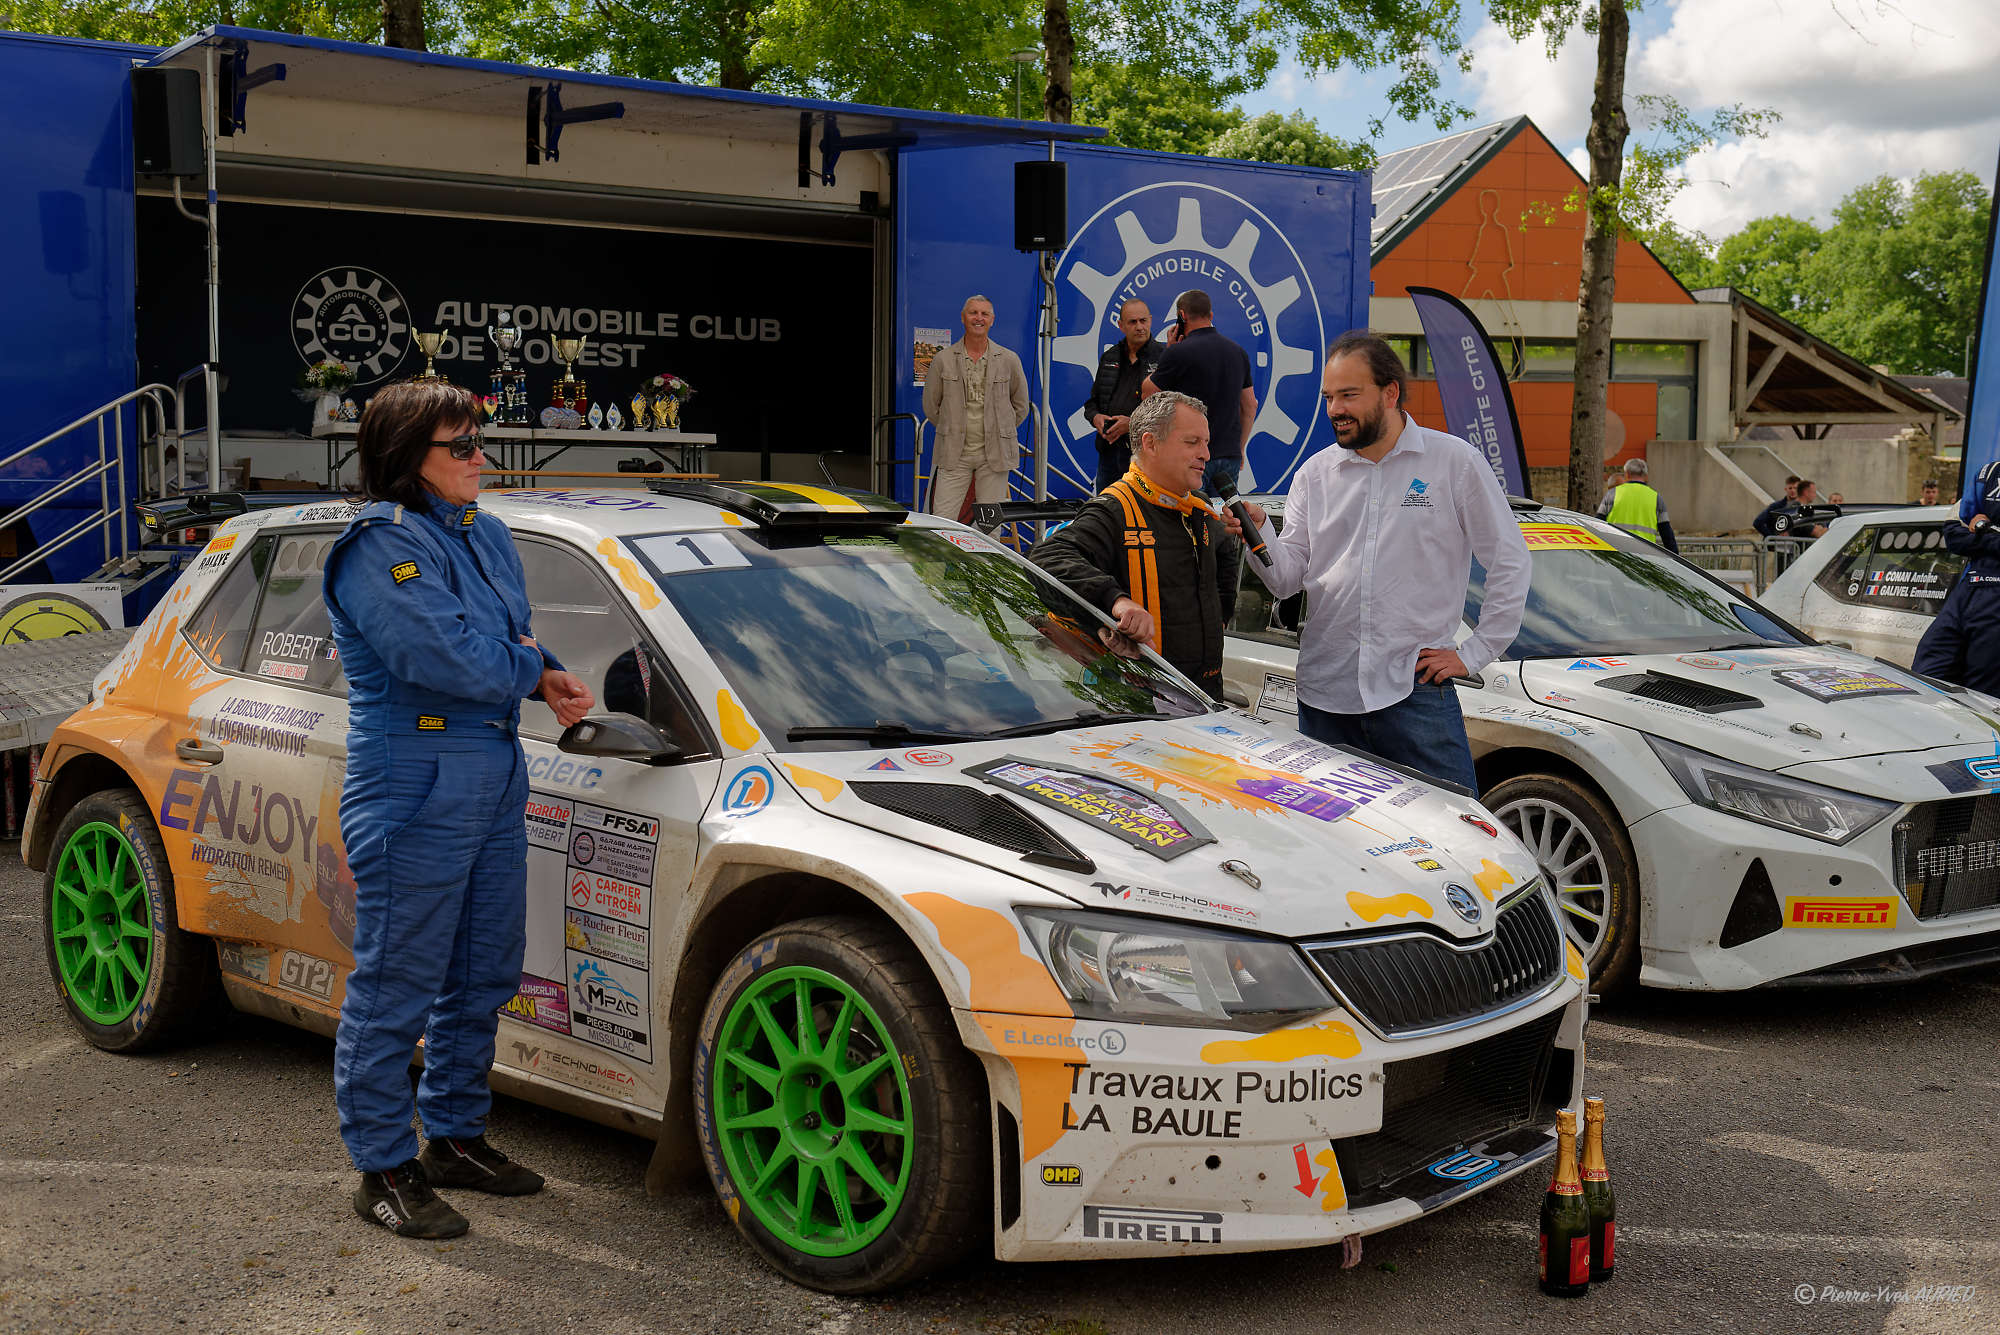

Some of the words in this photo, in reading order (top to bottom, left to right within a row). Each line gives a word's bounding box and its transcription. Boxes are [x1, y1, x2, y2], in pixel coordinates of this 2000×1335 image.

[319, 291, 368, 317] AUTOMOBILE
[368, 299, 385, 320] CLUB
[1228, 279, 1264, 337] CLUB
[434, 300, 679, 337] AUTOMOBILE
[689, 314, 782, 341] CLUB
[435, 335, 485, 361] DE
[302, 505, 341, 521] BRETAGNE
[675, 536, 715, 566] 1
[1122, 530, 1156, 546] 56
[198, 552, 231, 570] RALLYE
[393, 563, 418, 581] OMP
[1885, 571, 1912, 582] CONAN
[1910, 572, 1938, 584] Antoine
[1880, 585, 1909, 597] GALIVEL
[1909, 586, 1948, 600] Emmanuel
[260, 631, 323, 661] ROBERT
[220, 696, 238, 713] LA
[232, 698, 272, 721] BOISSON
[268, 704, 325, 730] FRANÇAISE
[419, 718, 444, 728] OMP
[217, 715, 261, 748] ÉNERGIE
[259, 726, 309, 758] POSITIVE
[1265, 783, 1308, 805] ENJOY
[160, 768, 318, 863] ENJOY
[602, 813, 650, 837] FFSA
[1078, 793, 1157, 826] RALLYE
[1153, 823, 1188, 839] DU
[599, 836, 625, 847] GARAGE
[626, 843, 652, 854] MARTIN
[1366, 841, 1416, 857] E.Leclerc
[191, 843, 256, 875] HYDRATION
[257, 857, 292, 883] REMEDY
[133, 840, 165, 925] MICHELIN
[1136, 886, 1257, 918] TECHNOMECA
[1792, 902, 1890, 924] PIRELLI
[569, 911, 581, 924] Le
[583, 915, 616, 935] Rucher
[618, 924, 646, 944] Fleuri
[586, 1016, 613, 1033] PIECES
[613, 1024, 635, 1040] AUTO
[588, 1029, 635, 1053] MISSILLAC
[1003, 1029, 1097, 1050] E.Leclerc
[544, 1049, 636, 1087] TECHNOMECA
[1064, 1062, 1223, 1103] Travaux
[1236, 1069, 1363, 1104] Publics
[696, 1050, 721, 1176] MICHELIN
[1061, 1104, 1111, 1133] LA
[1131, 1106, 1242, 1139] BAULE
[1043, 1166, 1080, 1182] OMP
[1555, 1183, 1577, 1192] OPERA
[1083, 1204, 1224, 1244] PIRELLI
